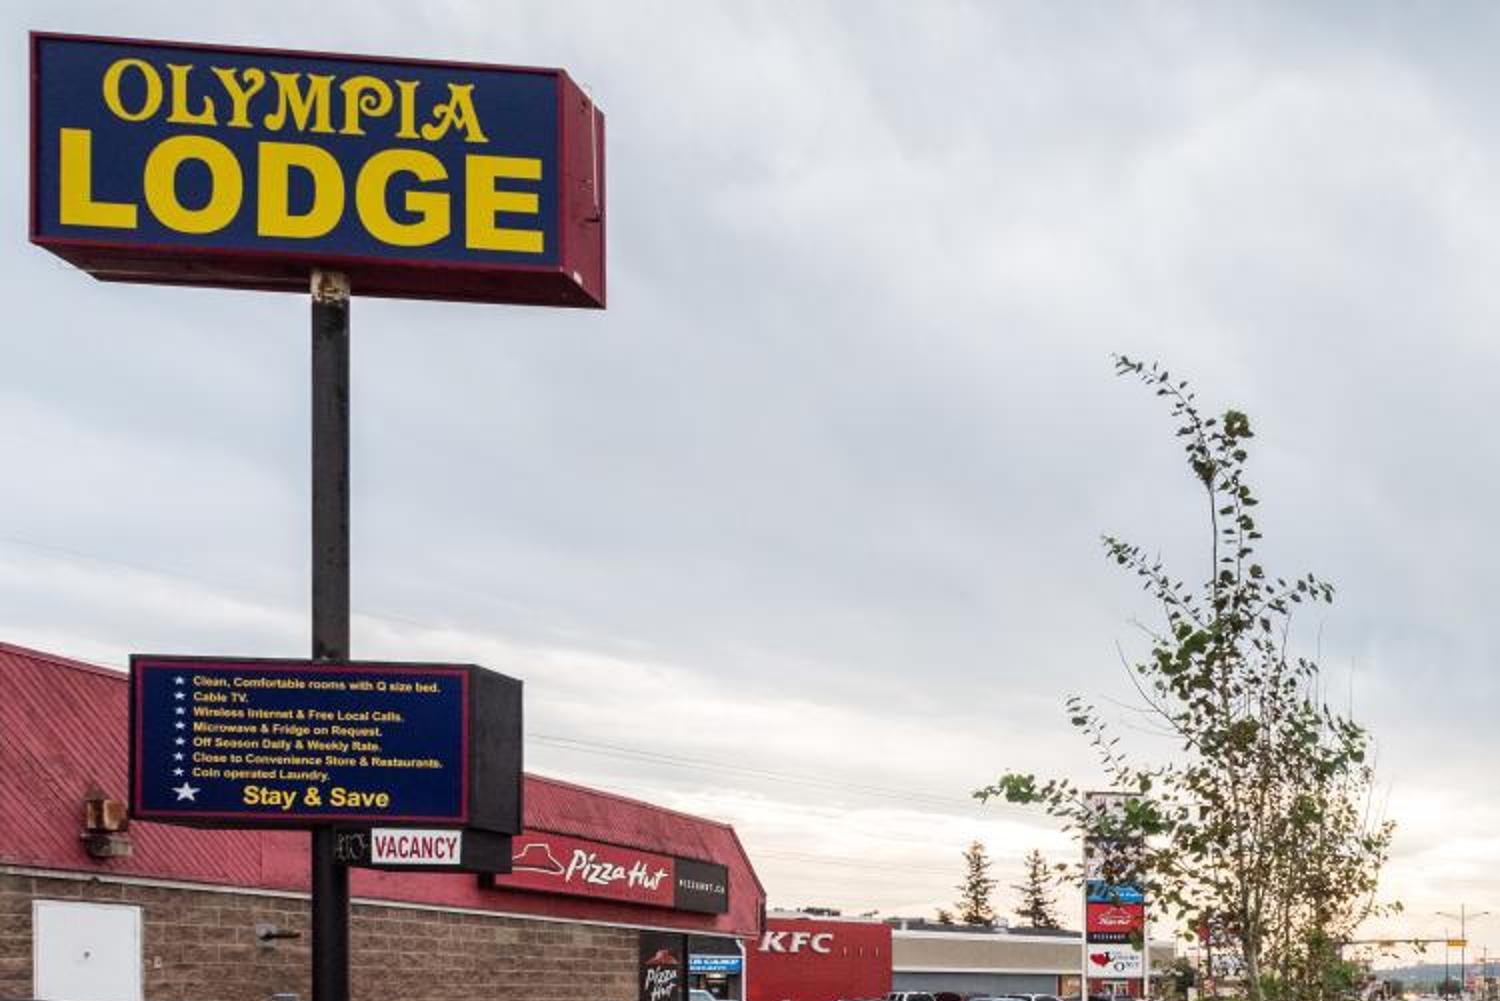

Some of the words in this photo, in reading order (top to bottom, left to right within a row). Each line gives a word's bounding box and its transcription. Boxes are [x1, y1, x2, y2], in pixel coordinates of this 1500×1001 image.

[102, 58, 488, 143] OLYMPIA
[59, 127, 544, 253] LODGE
[192, 676, 231, 687] Clean,
[233, 677, 305, 689] Comfortable
[308, 682, 346, 690] rooms
[349, 681, 373, 690] with
[376, 681, 386, 691] Q
[389, 683, 412, 692] size
[415, 682, 441, 693] bed.
[193, 691, 227, 702] Cable
[193, 706, 244, 718] Wireless
[248, 708, 292, 719] Internet
[295, 709, 305, 719] &
[308, 710, 334, 720] Free
[337, 710, 369, 720] Local
[193, 722, 257, 733] Microwave
[260, 723, 269, 733] &
[272, 723, 310, 736] Fridge
[313, 727, 329, 735] on
[331, 725, 382, 738] Request.
[193, 737, 212, 747] Off
[215, 738, 258, 748] Season
[261, 739, 290, 751] Daily
[295, 740, 304, 750] &
[307, 740, 349, 752] Weekly
[192, 752, 226, 763] Close
[230, 754, 243, 763] to
[245, 754, 322, 766] Convenience
[325, 755, 356, 766] Store
[359, 757, 369, 767] &
[192, 767, 220, 778] Coin
[223, 769, 276, 780] operated
[243, 785, 296, 810] Stay
[303, 787, 322, 807] &
[330, 787, 390, 808] Save
[375, 835, 457, 859] VACANCY
[565, 849, 627, 885] Pizza
[624, 860, 669, 891] Hut
[757, 931, 834, 953] KFC
[645, 966, 677, 991] Pizza
